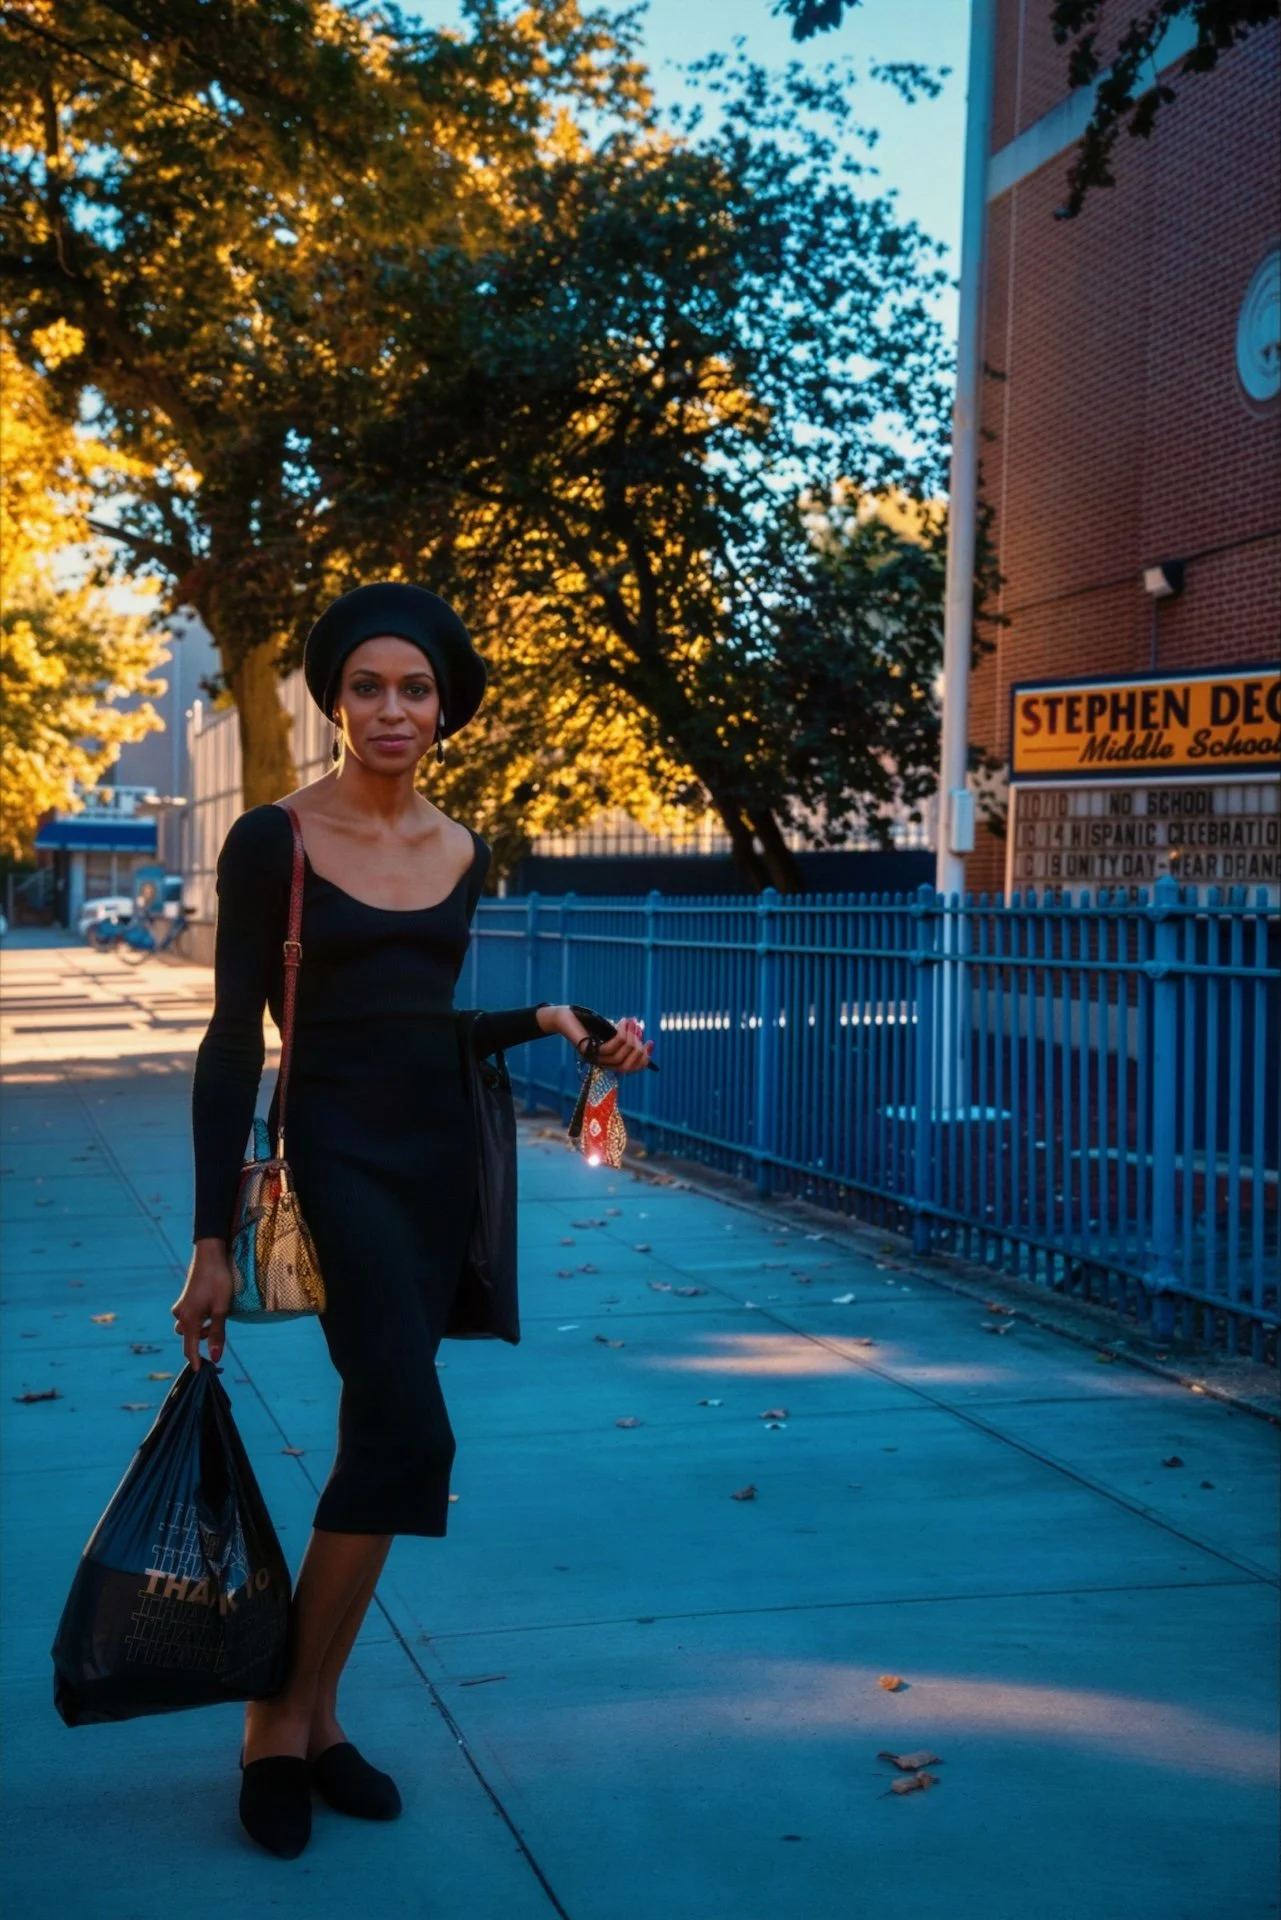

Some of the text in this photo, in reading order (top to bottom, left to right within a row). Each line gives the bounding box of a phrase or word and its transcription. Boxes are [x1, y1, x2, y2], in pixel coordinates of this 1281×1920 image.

[1021, 687, 1190, 737] STEPHEN
[1078, 731, 1175, 763] Middle
[1110, 791, 1131, 815] NO
[1147, 790, 1214, 815] SCHOOL
[1071, 822, 1157, 847] HISPANIC
